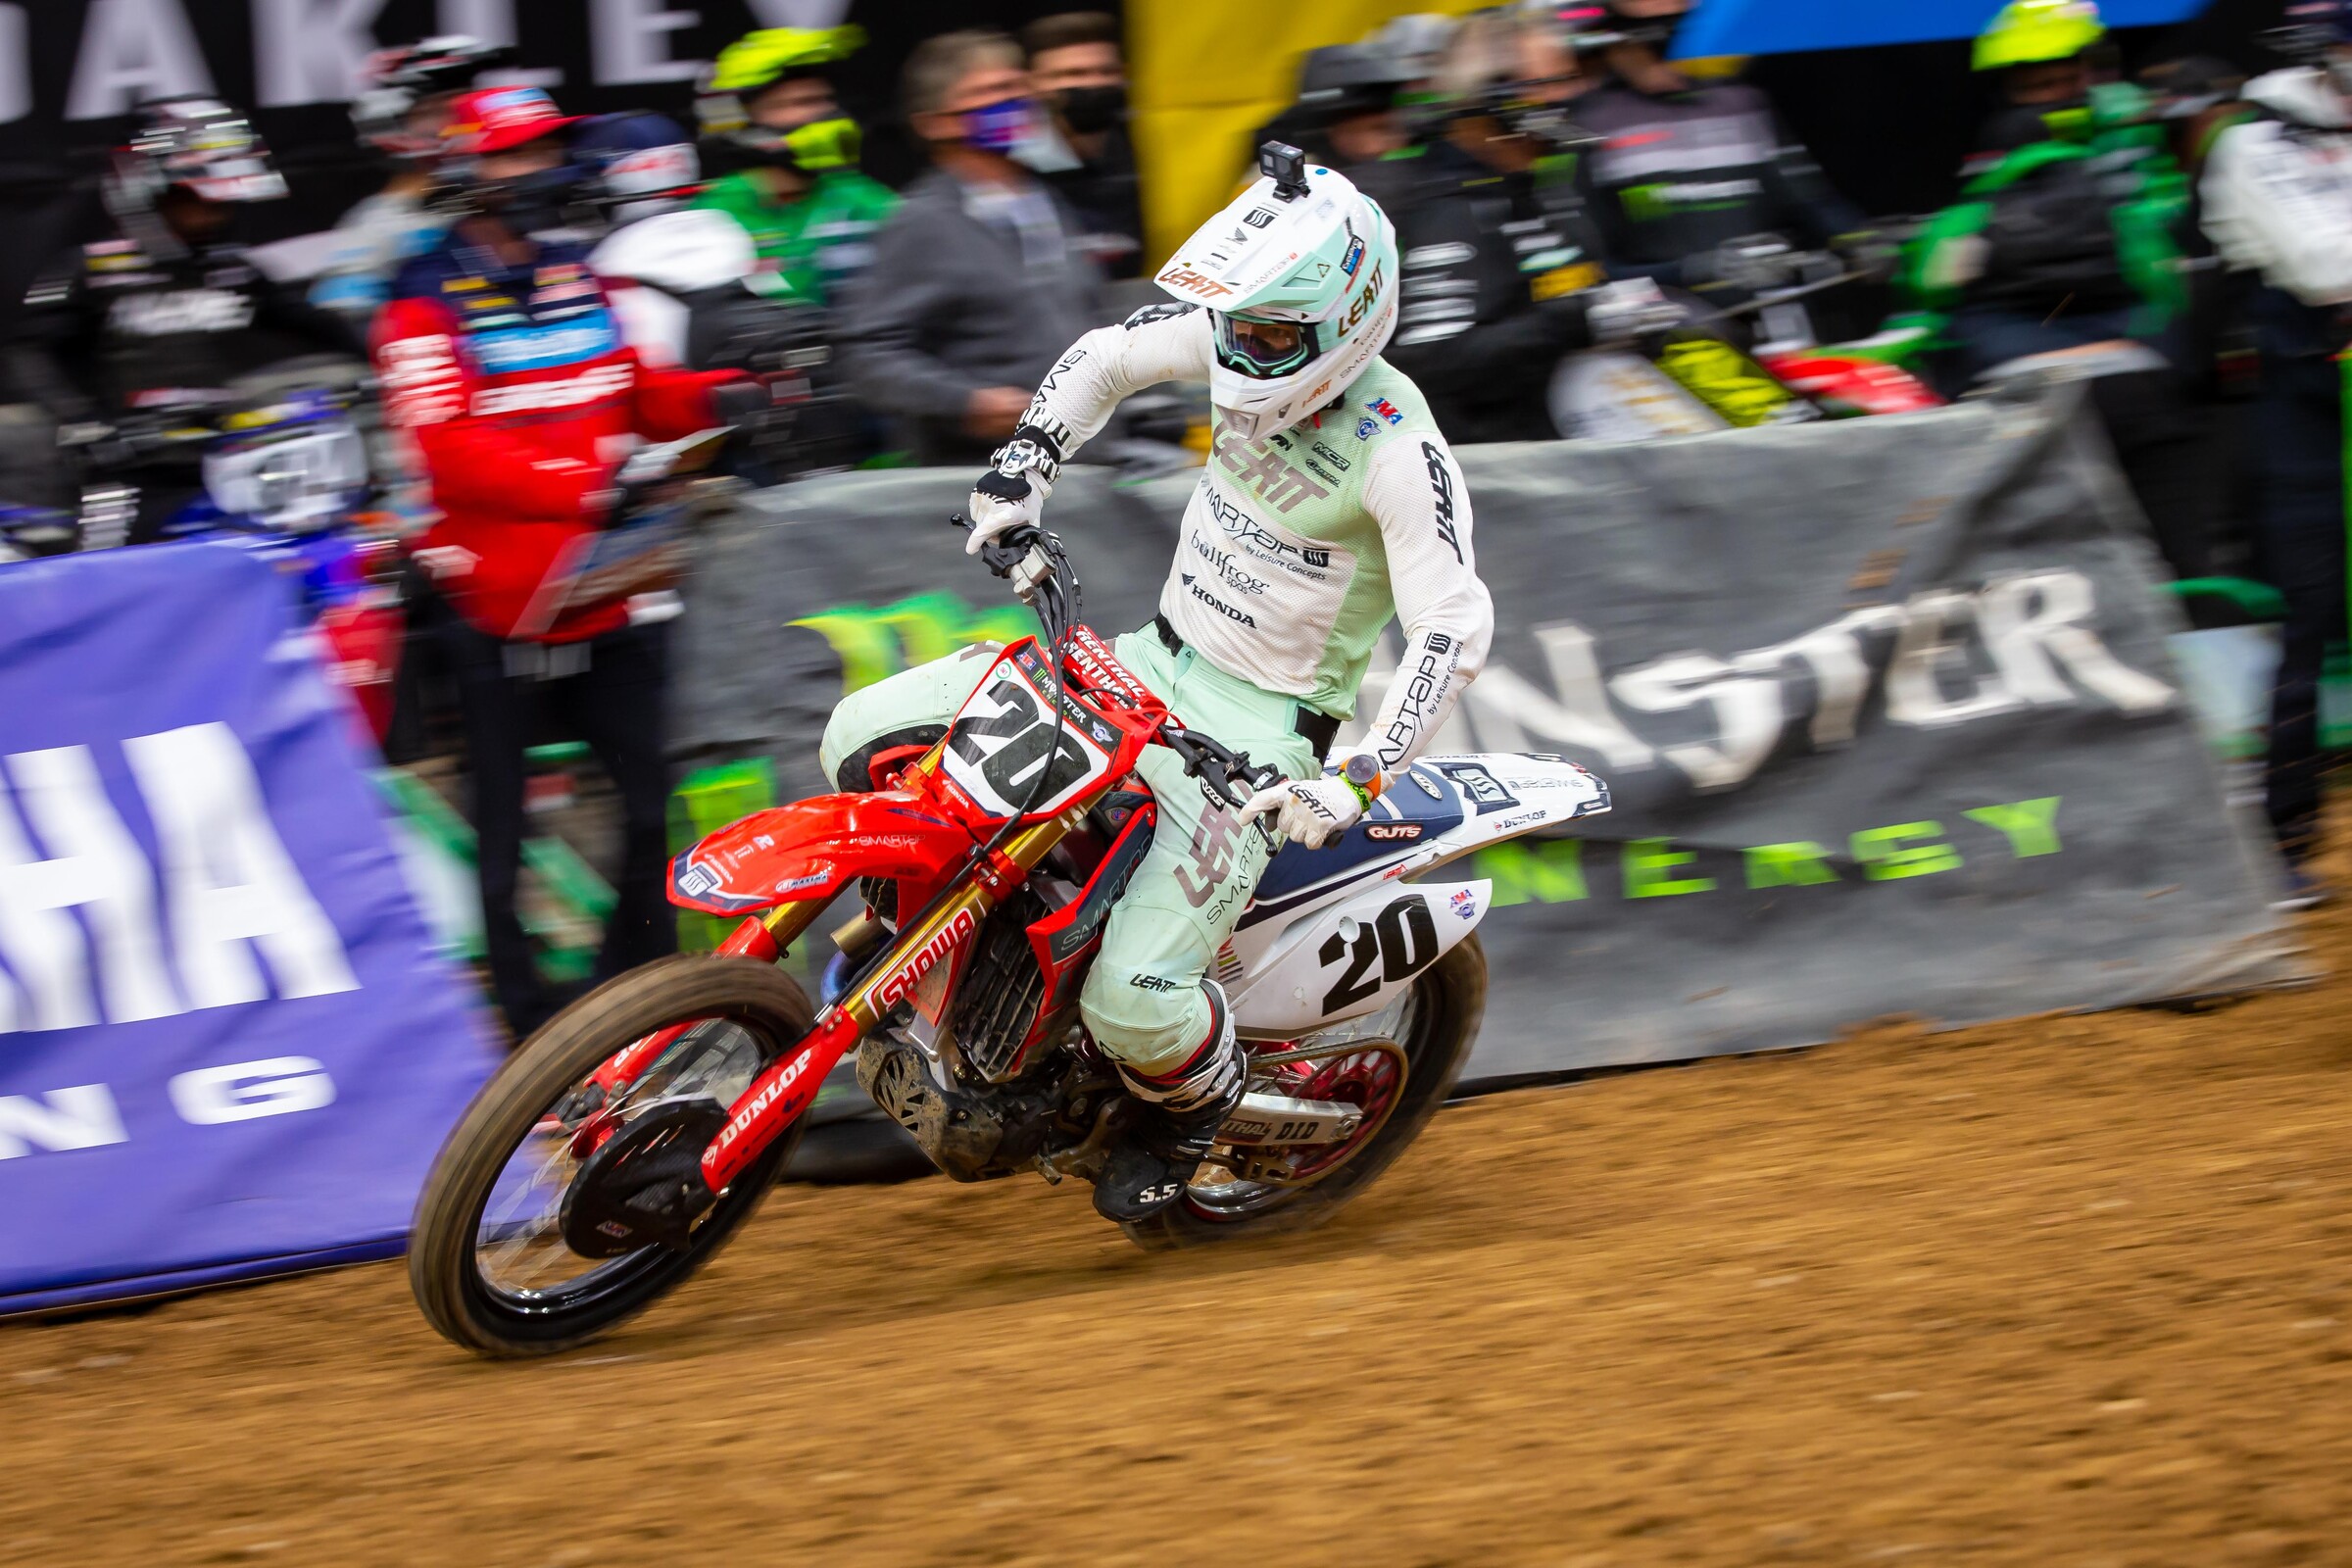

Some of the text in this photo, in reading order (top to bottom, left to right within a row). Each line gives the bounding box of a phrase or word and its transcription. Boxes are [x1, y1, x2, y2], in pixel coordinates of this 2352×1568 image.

[1157, 268, 1234, 298] LEATT
[1338, 258, 1383, 338] LEATT
[1213, 421, 1330, 514] LEATT
[1313, 441, 1350, 469] MCR
[1422, 441, 1464, 565] LEATT
[1246, 544, 1326, 581] by Leisure Concepts
[1225, 576, 1249, 595] spas
[1191, 584, 1257, 629] HONDA
[1076, 630, 1147, 698] RENTHAL
[1432, 674, 1450, 704] Leisure
[1427, 705, 1438, 715] by
[948, 680, 1091, 813] 20
[947, 784, 969, 809] HONDA
[1287, 785, 1338, 821] LEATT
[1368, 824, 1422, 838] GUTS
[1503, 809, 1546, 829] DUNLOP
[858, 834, 926, 849] SMARTOP
[880, 907, 976, 1011] SHOWA
[1318, 893, 1439, 1017] 20
[1130, 973, 1177, 994] LEATT
[719, 1049, 811, 1150] DUNLOP
